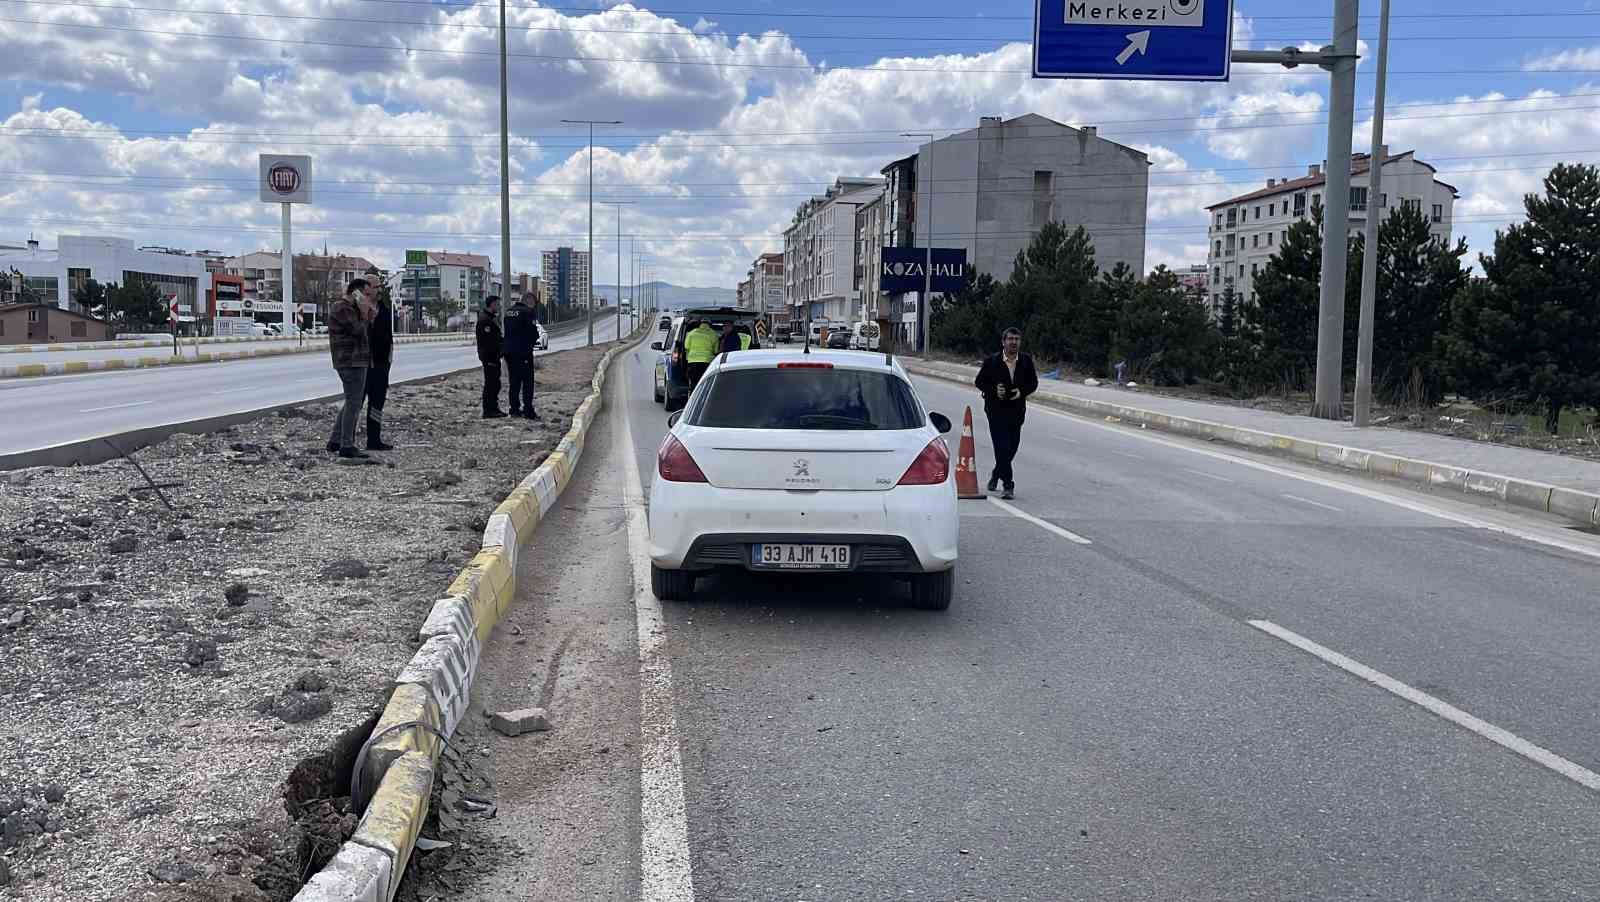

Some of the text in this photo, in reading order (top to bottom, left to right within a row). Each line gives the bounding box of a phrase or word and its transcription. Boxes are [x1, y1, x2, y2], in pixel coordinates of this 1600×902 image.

[1069, 2, 1166, 20] Merkezi
[274, 171, 295, 187] FIAT
[883, 262, 962, 277] KOZA HALI
[764, 546, 847, 563] 33 AJM 418
